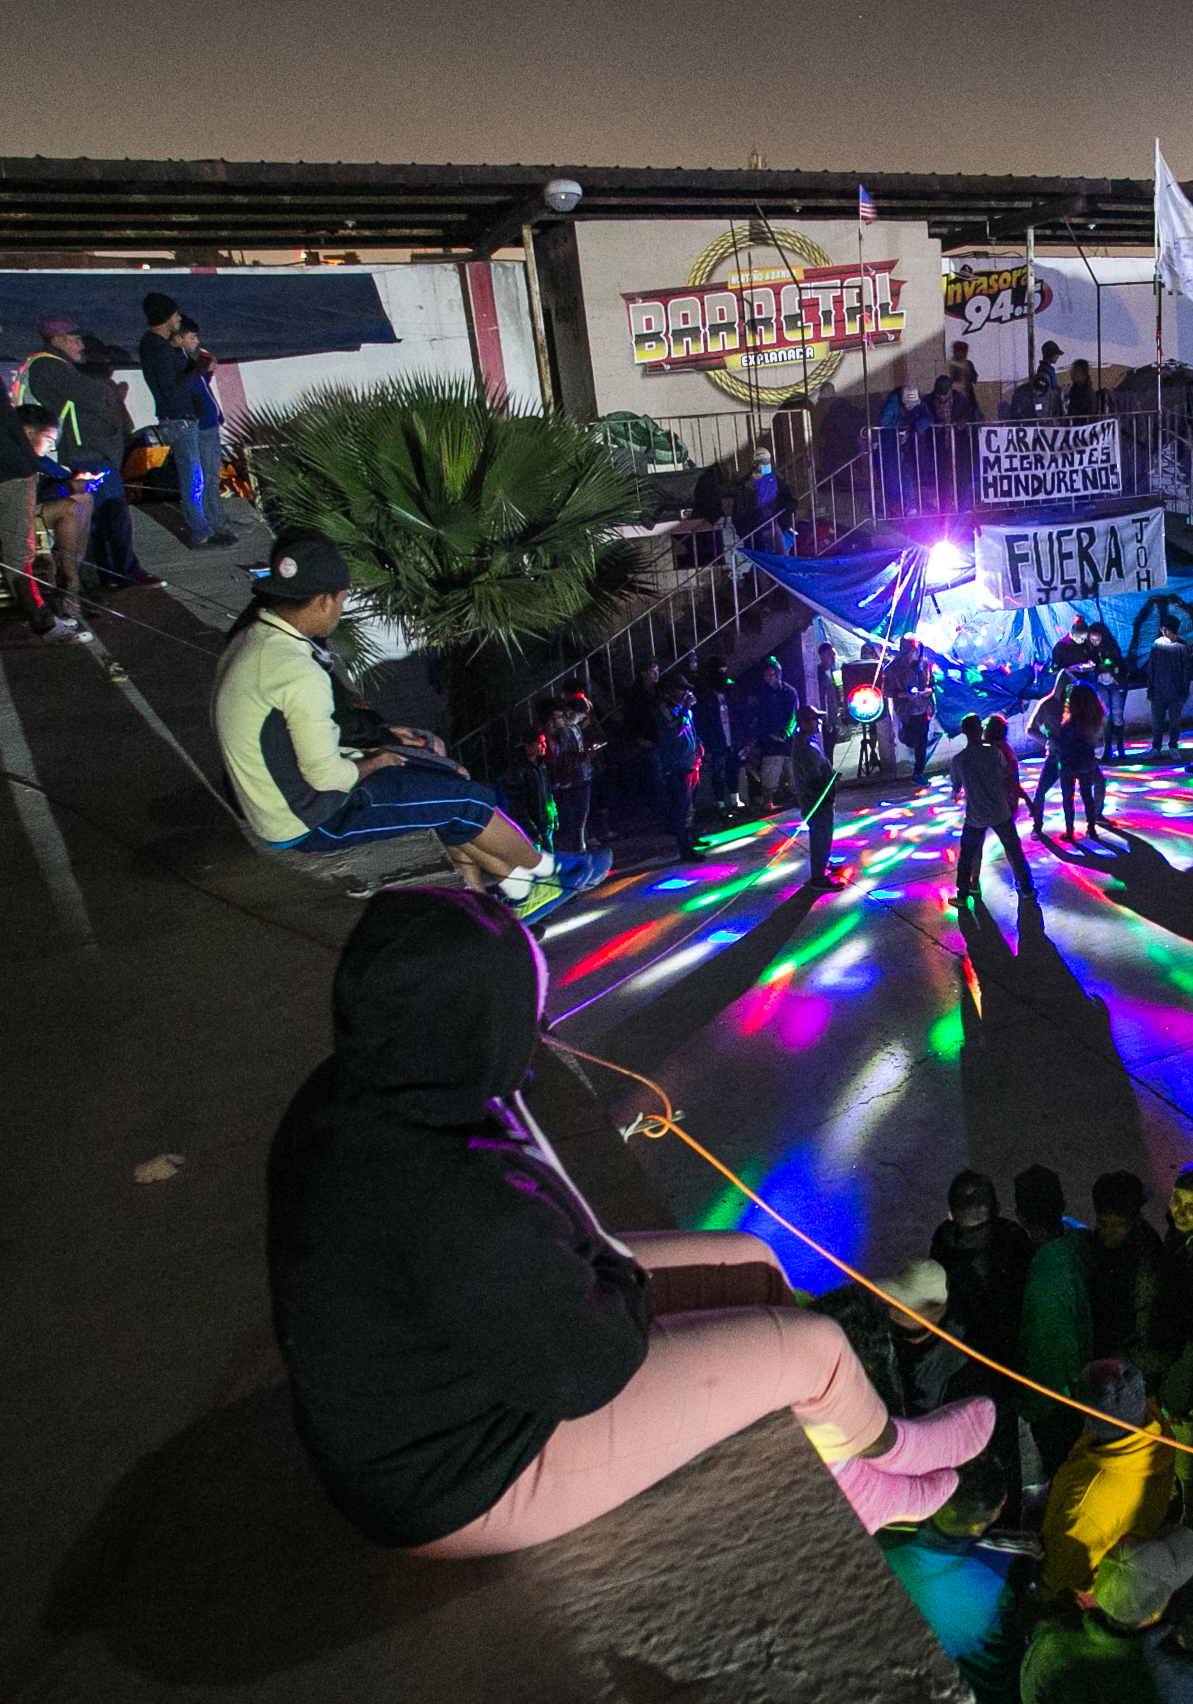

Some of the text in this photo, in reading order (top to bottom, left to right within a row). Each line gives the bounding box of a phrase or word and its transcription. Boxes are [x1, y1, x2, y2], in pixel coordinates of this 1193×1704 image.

[629, 272, 907, 364] BARRETAL
[741, 346, 815, 367] EXPLANADA
[982, 447, 1111, 474] MIGRANTES
[1005, 525, 1125, 594] FUERA
